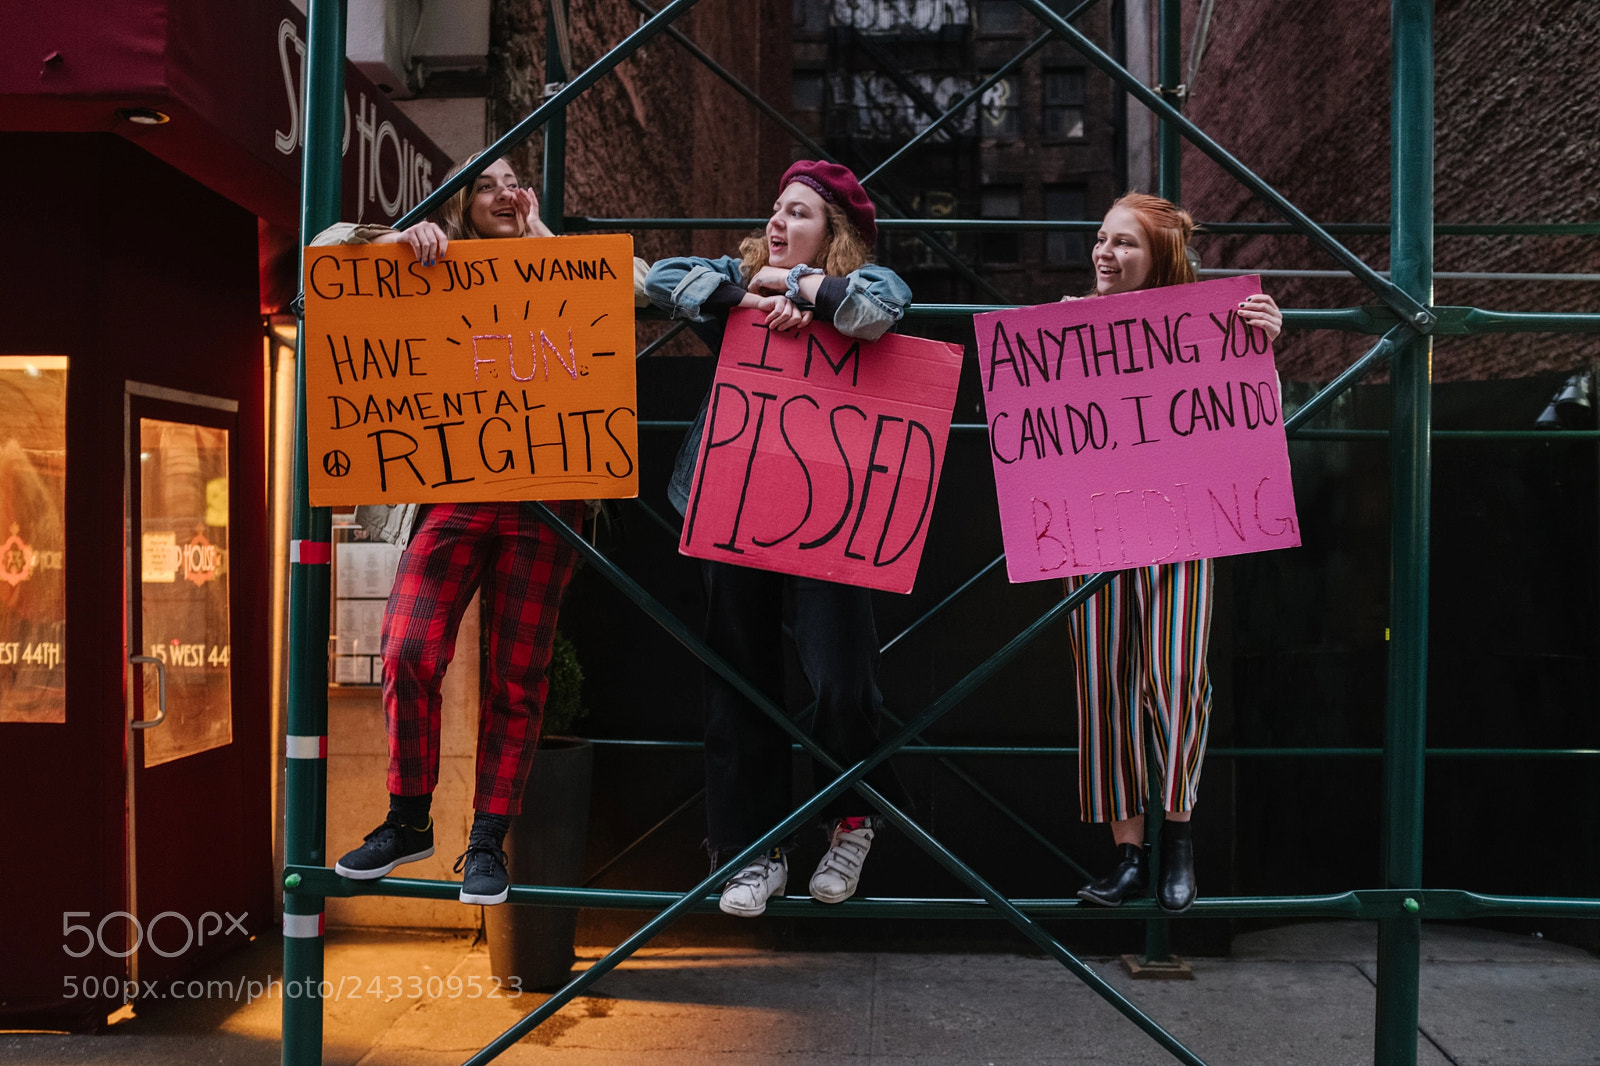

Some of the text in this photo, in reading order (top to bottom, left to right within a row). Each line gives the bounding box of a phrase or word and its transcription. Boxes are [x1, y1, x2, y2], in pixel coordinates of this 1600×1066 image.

[310, 255, 617, 300] GIRLS JUST WANNA
[327, 328, 578, 384] HAVE FUN
[988, 309, 1268, 392] ANYTHING YOU
[327, 390, 546, 430] DAMENTAL
[1121, 395, 1160, 446] I
[367, 407, 636, 492] RIGHTS
[686, 383, 935, 567] PISSED
[1030, 476, 1295, 572] BLEEDING
[183, 544, 215, 580] HOUSE
[21, 642, 60, 670] 44TH
[169, 643, 205, 666] WEST
[207, 644, 230, 667] 44
